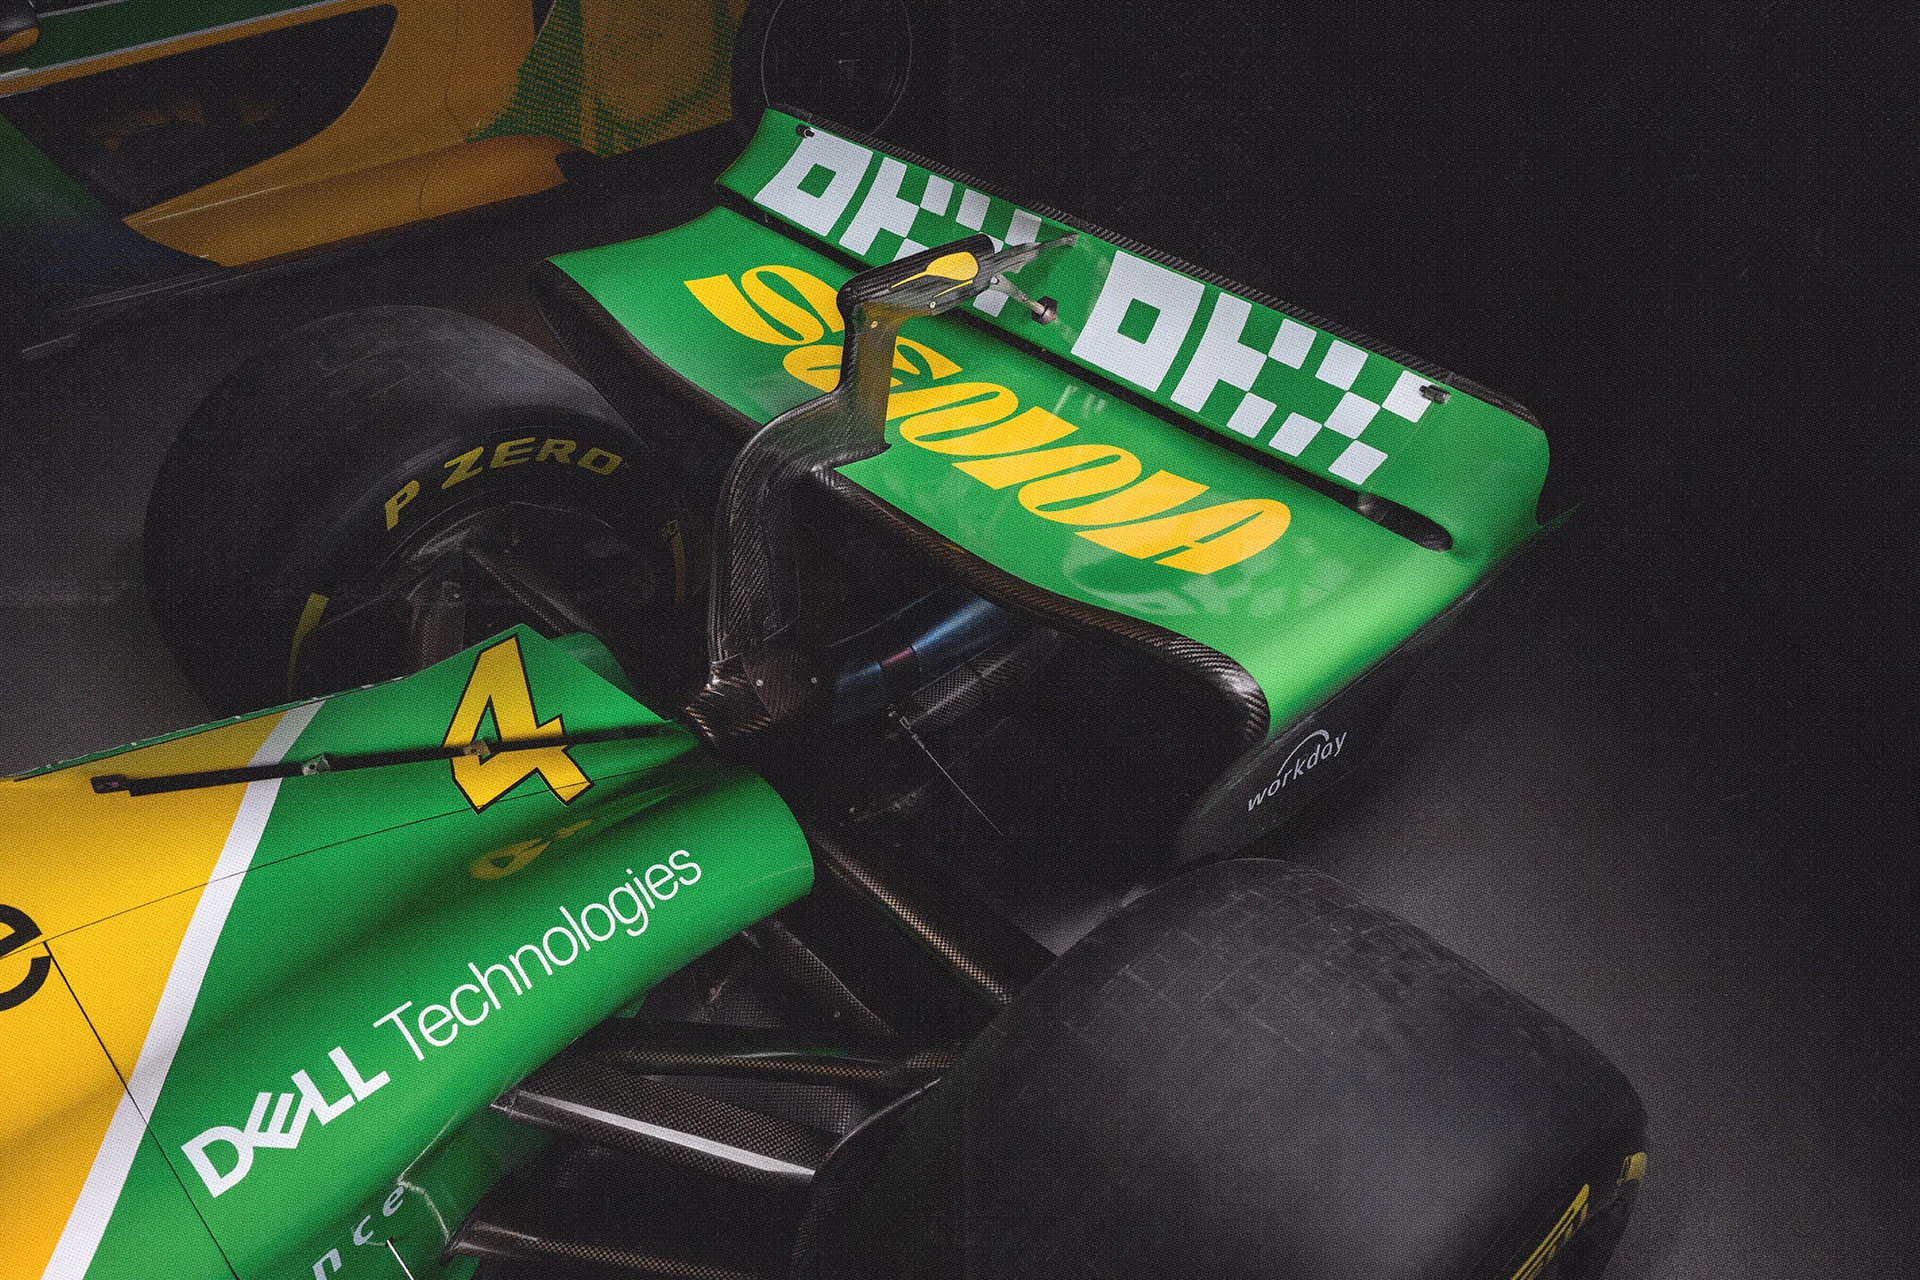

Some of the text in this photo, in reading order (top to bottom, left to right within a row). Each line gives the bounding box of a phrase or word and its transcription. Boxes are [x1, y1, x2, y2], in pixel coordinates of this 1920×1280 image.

[1071, 250, 1433, 485] OKX
[385, 436, 623, 531] P ZERO
[441, 634, 593, 814] 4
[1247, 729, 1347, 812] workday
[181, 849, 702, 1198] DELL Technologies
